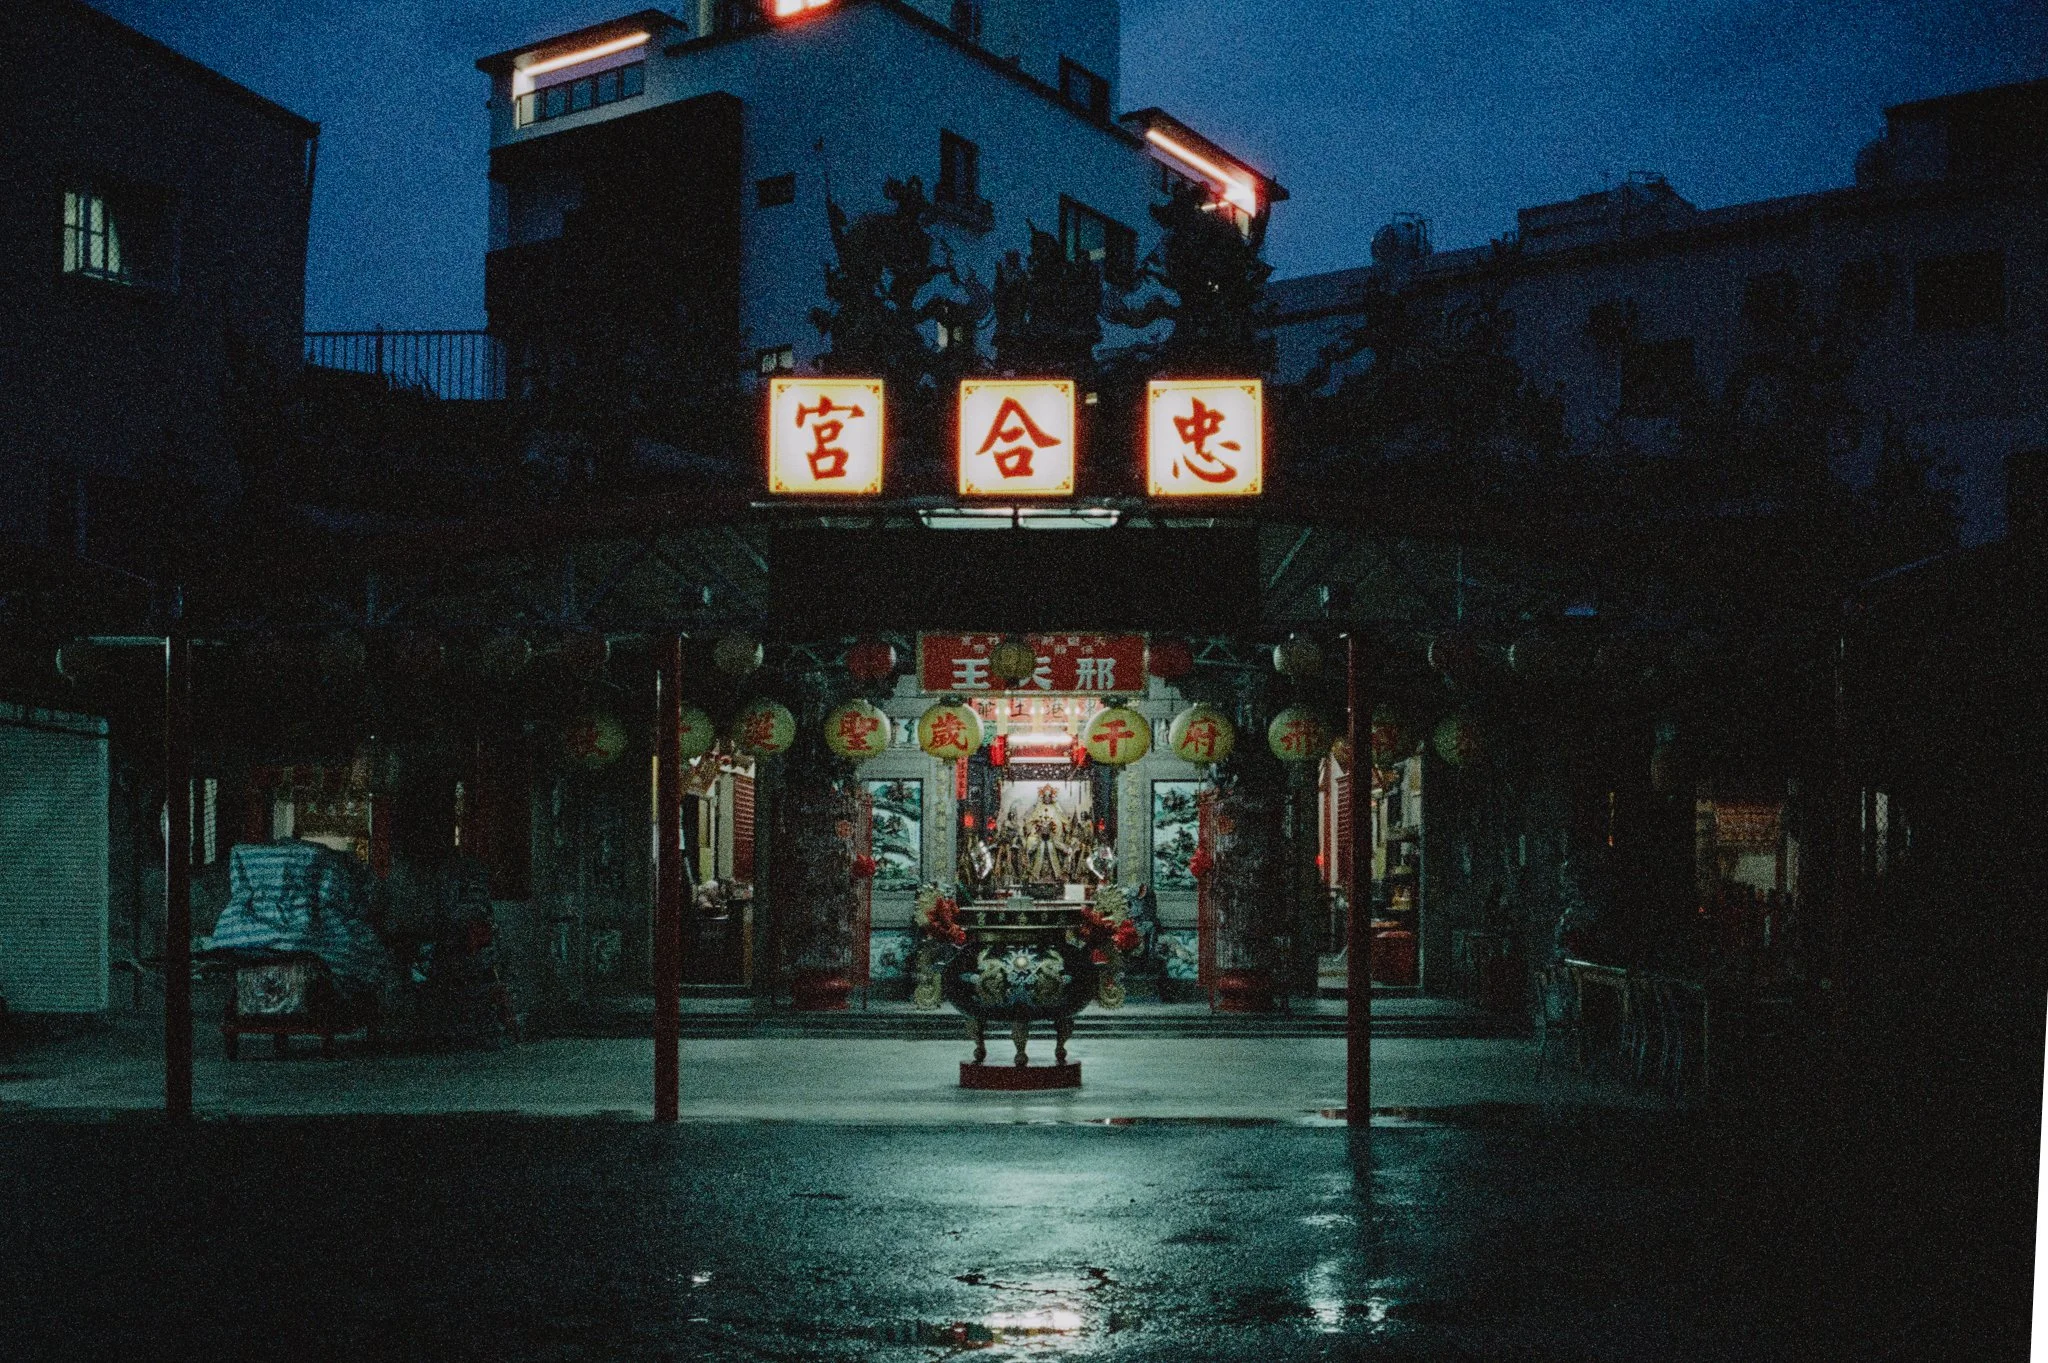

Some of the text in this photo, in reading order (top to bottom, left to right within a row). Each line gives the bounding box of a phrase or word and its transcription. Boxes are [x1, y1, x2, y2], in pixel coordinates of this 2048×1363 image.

[796, 395, 1241, 483] 忠 合 宮
[928, 712, 968, 750] 歲
[1092, 719, 1135, 757] 千
[1181, 716, 1220, 757] 府
